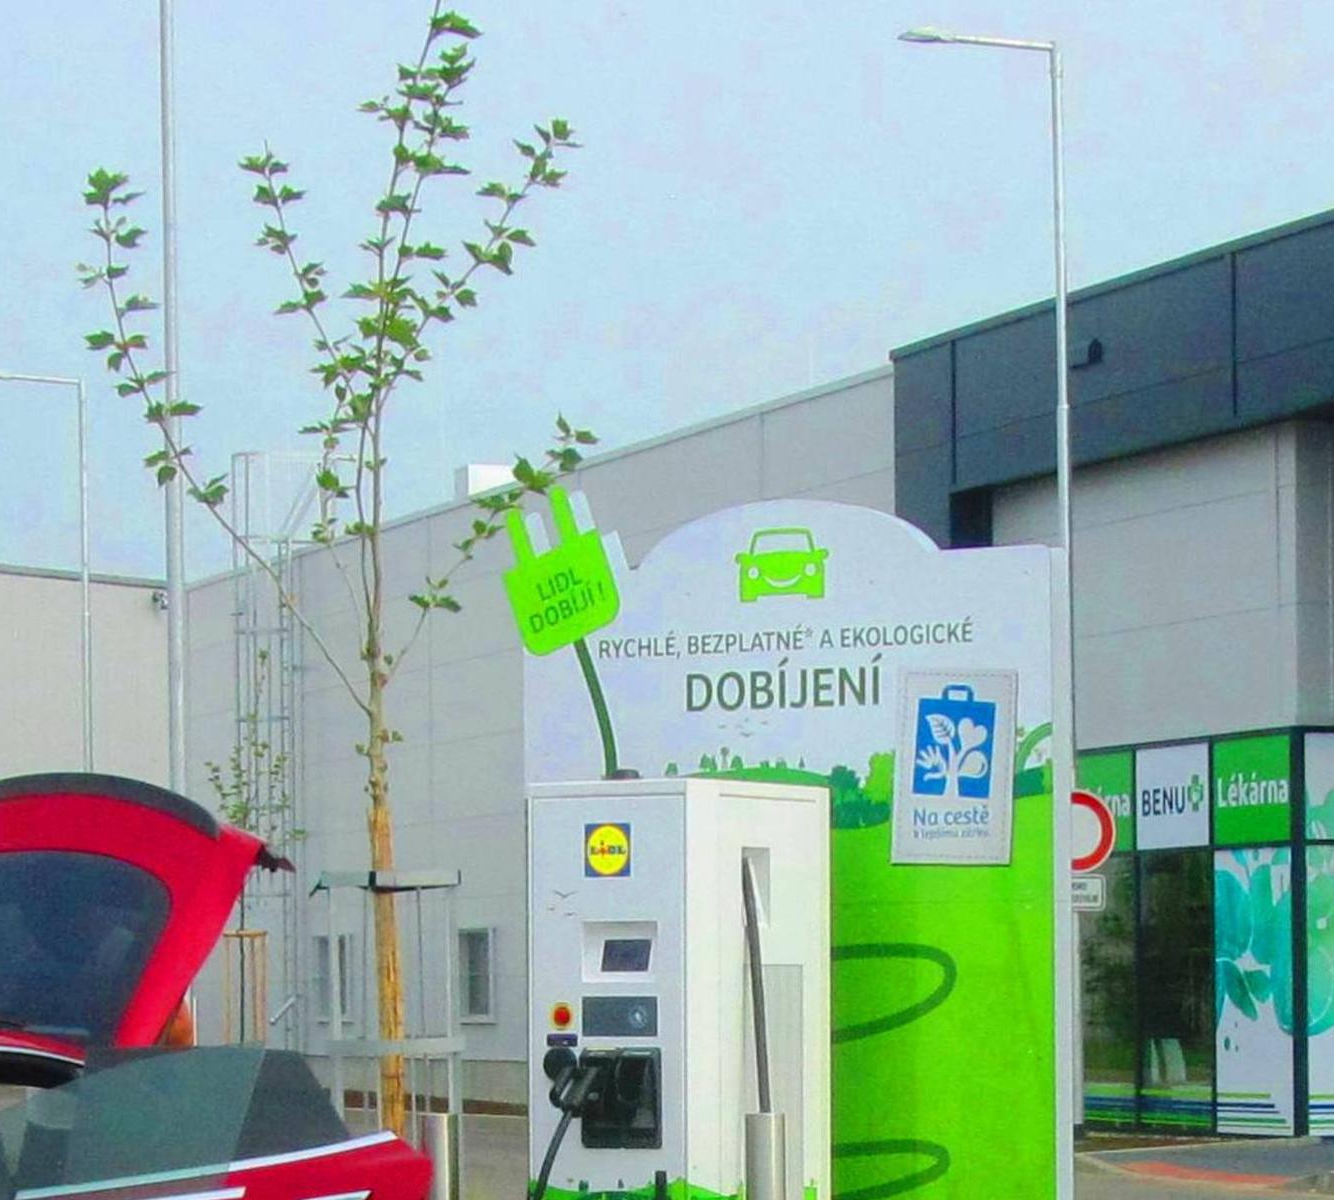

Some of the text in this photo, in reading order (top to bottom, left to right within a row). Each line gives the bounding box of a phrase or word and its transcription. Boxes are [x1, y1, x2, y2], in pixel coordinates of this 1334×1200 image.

[536, 568, 583, 601] LIDL
[598, 630, 681, 660] RYCHLÉ,
[820, 629, 834, 649] A
[840, 616, 974, 649] EKOLOGICKÉ
[686, 652, 883, 712] DOBÍJENÍ
[1141, 787, 1186, 817] BENU
[1216, 772, 1290, 809] Lékárna
[913, 805, 990, 826] Na cestě
